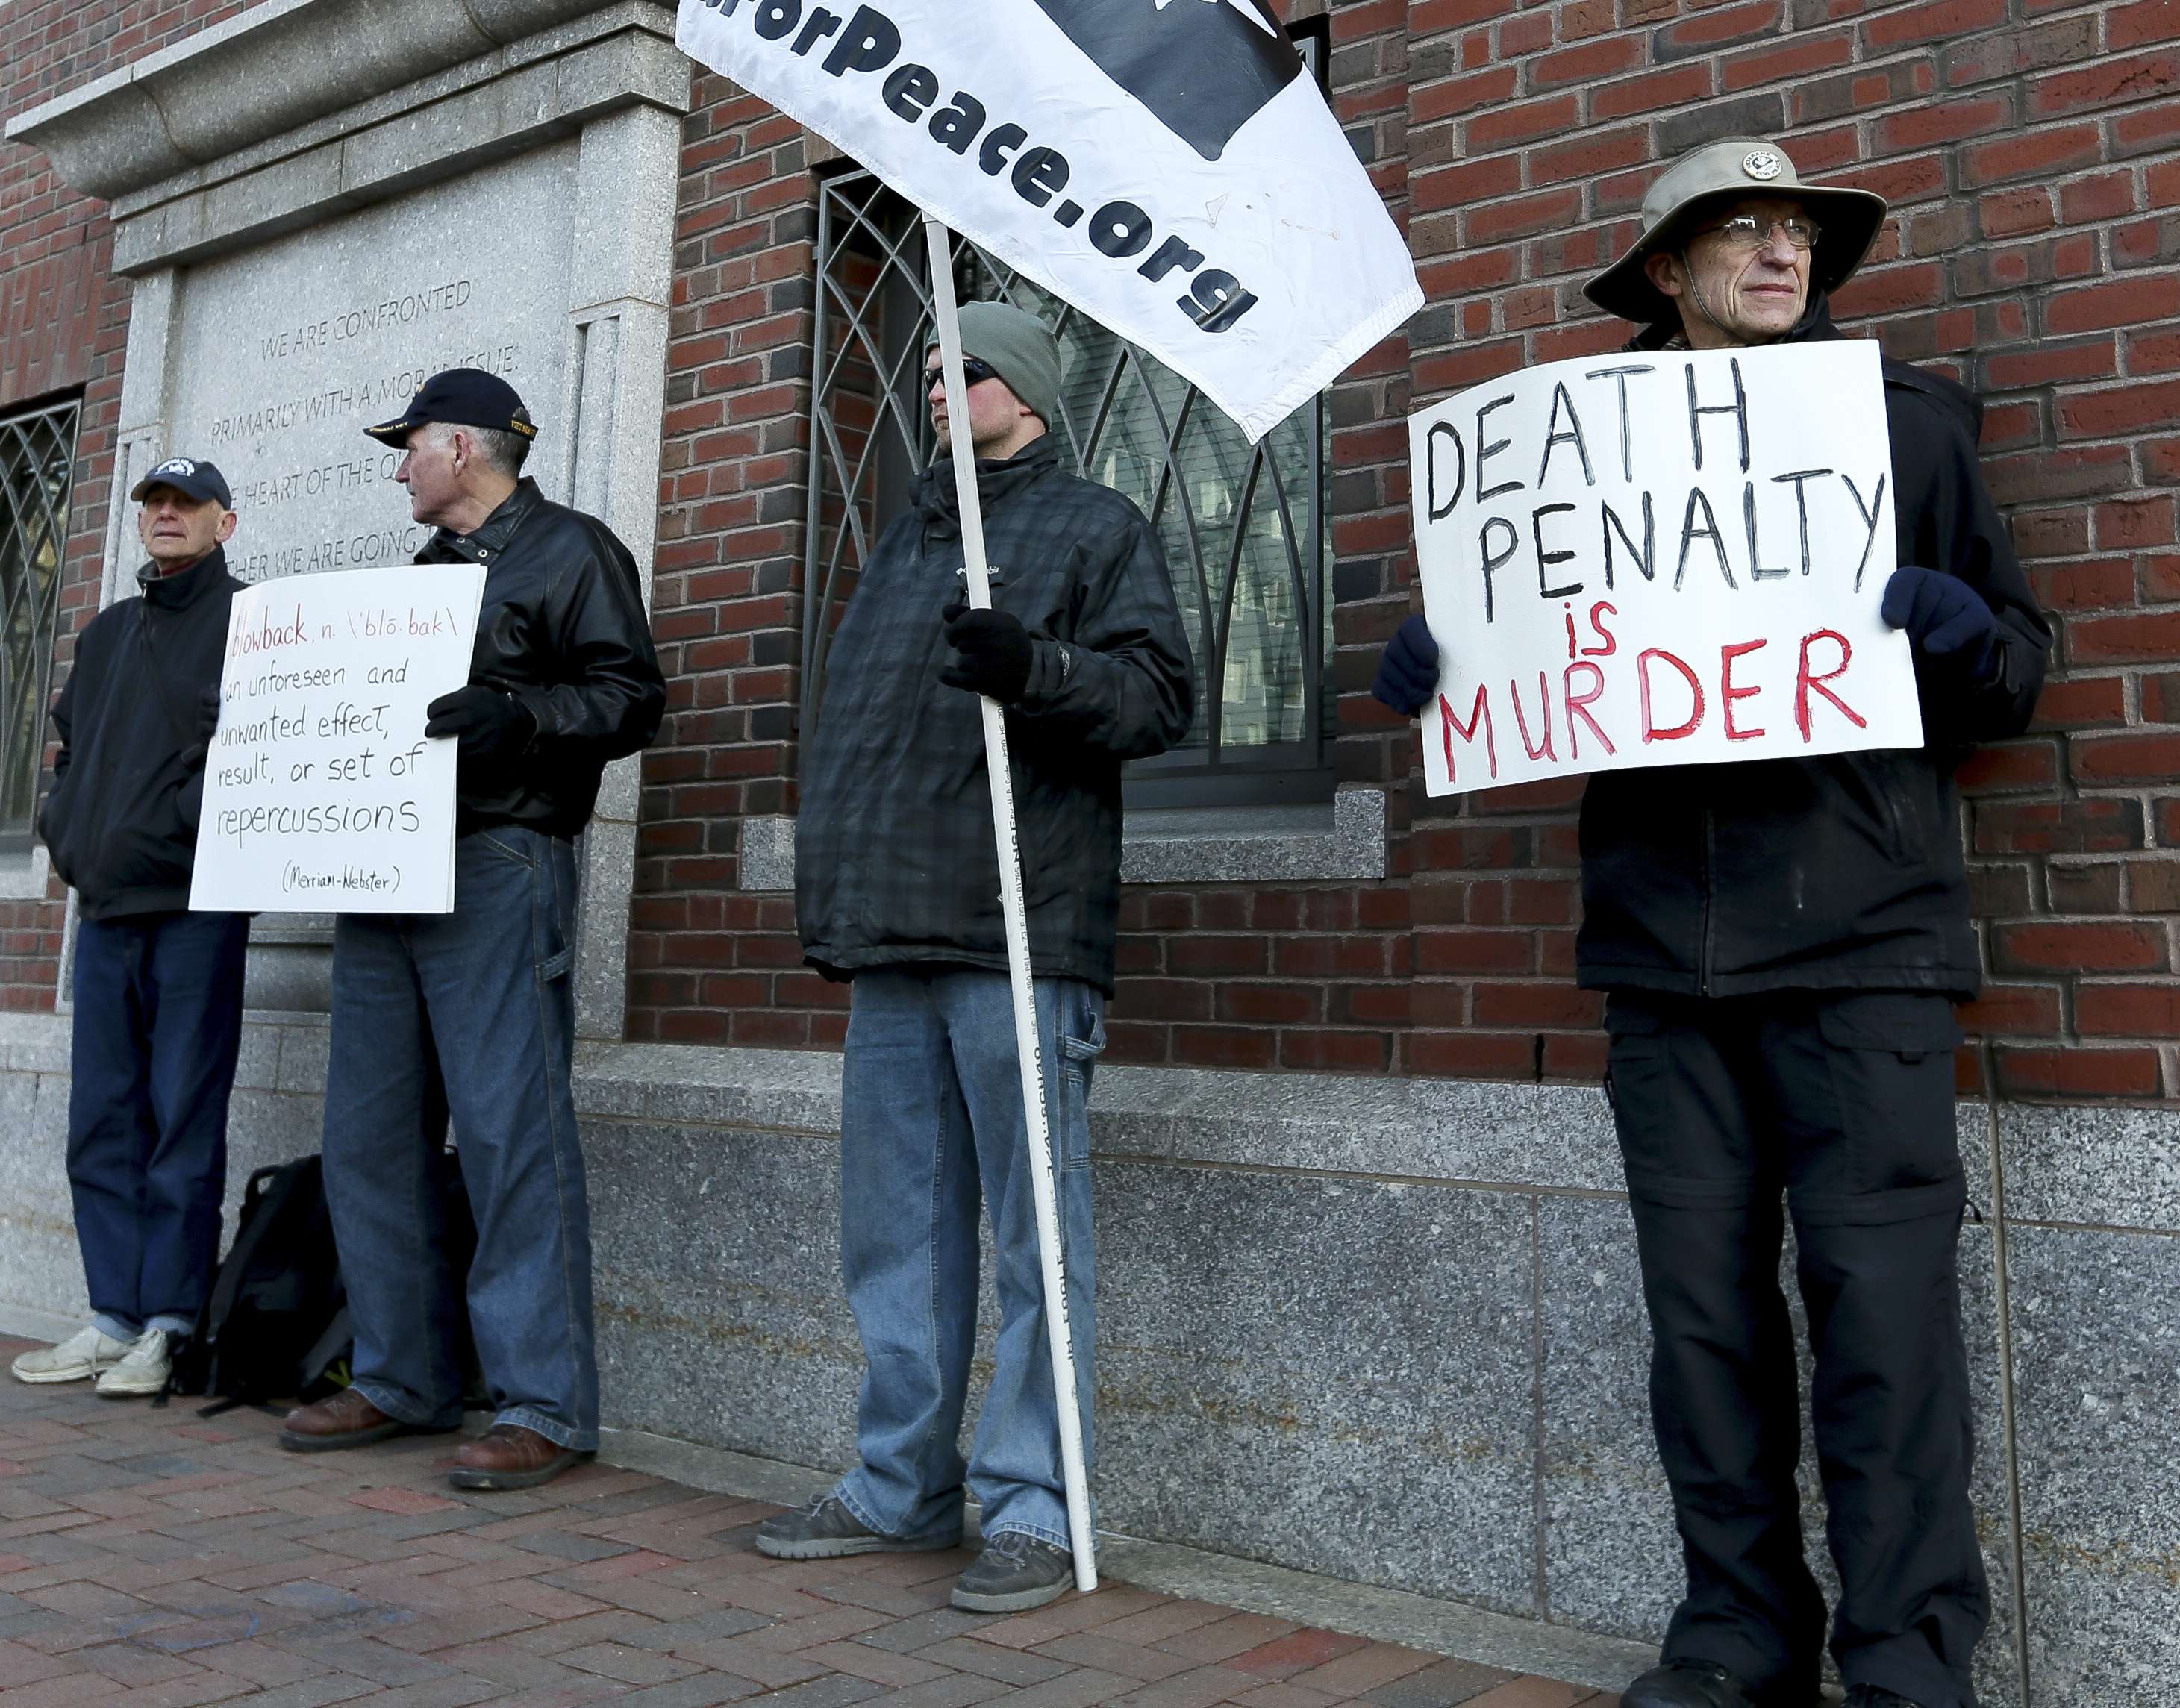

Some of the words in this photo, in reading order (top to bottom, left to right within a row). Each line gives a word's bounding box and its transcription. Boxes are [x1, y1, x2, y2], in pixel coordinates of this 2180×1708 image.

[260, 334, 289, 362] WE
[294, 322, 328, 350] ARE
[334, 280, 472, 341] CONFRONTED
[210, 401, 299, 445] PRIMARILY
[304, 387, 353, 422] WITH
[358, 383, 371, 409] A
[1427, 357, 1749, 525] DEATH
[243, 473, 302, 509] HEART
[307, 466, 333, 495] OF
[337, 458, 374, 488] THE
[275, 548, 302, 574] WE
[307, 541, 345, 571] ARE
[351, 525, 417, 563] GOING
[1478, 469, 1885, 624] PENALTY
[225, 680, 241, 703] an
[249, 660, 345, 698] unforeseen
[366, 658, 409, 683] and
[1438, 627, 1867, 783] MURDER
[221, 705, 306, 746] unwanted
[318, 701, 390, 740] effect,
[219, 753, 275, 787] result,
[290, 762, 316, 782] or
[328, 747, 375, 781] set
[389, 741, 428, 777] of
[217, 799, 419, 849] repercussions
